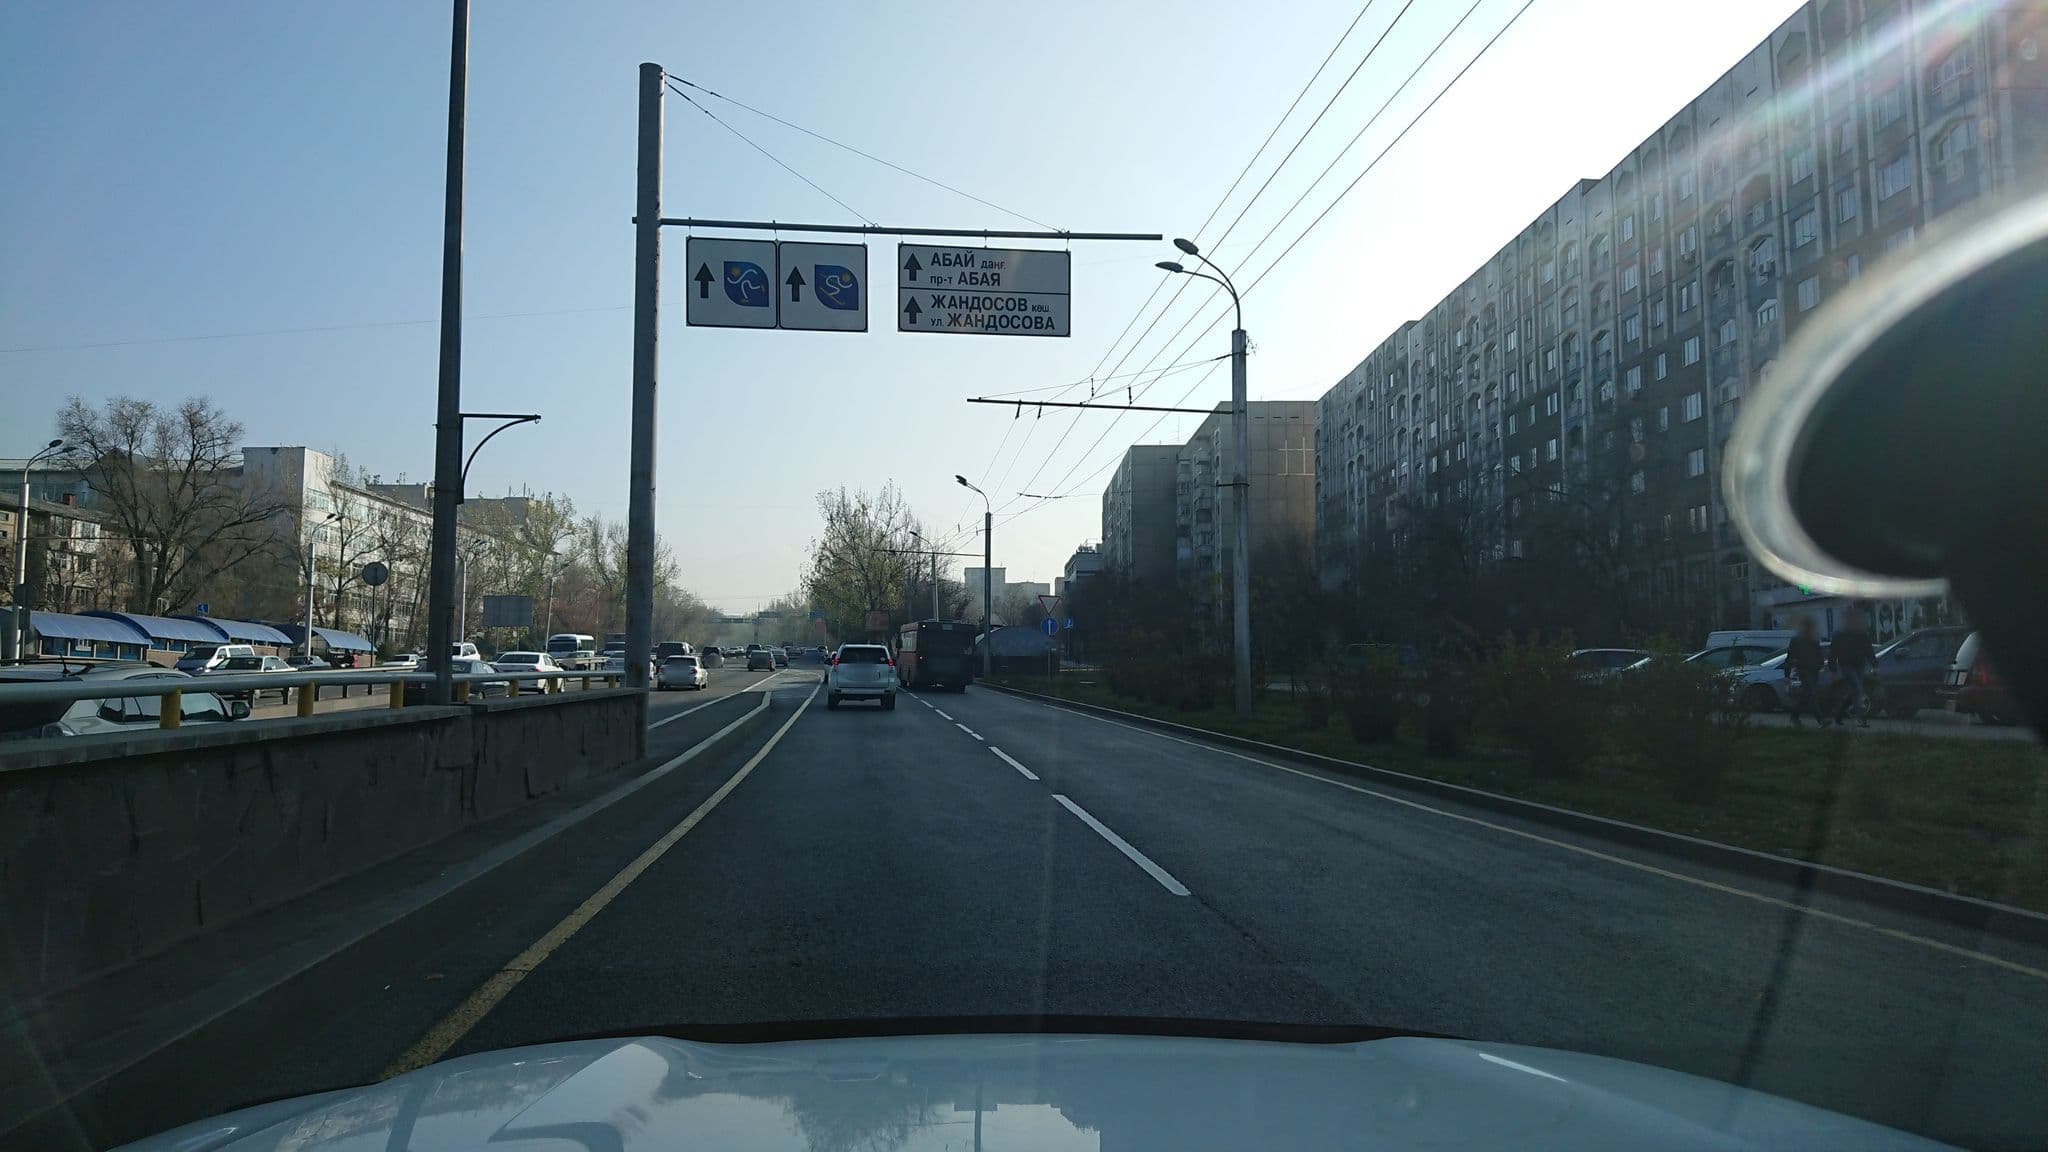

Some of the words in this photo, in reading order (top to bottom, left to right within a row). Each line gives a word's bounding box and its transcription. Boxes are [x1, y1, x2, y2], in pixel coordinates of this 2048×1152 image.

[930, 250, 975, 267] АБАЙ
[930, 275, 953, 286] пр-т
[957, 272, 1001, 287] АБАЯ
[931, 294, 1028, 313] ЖАНДОСОВ
[947, 313, 1055, 331] ЖАНДОСОВА
